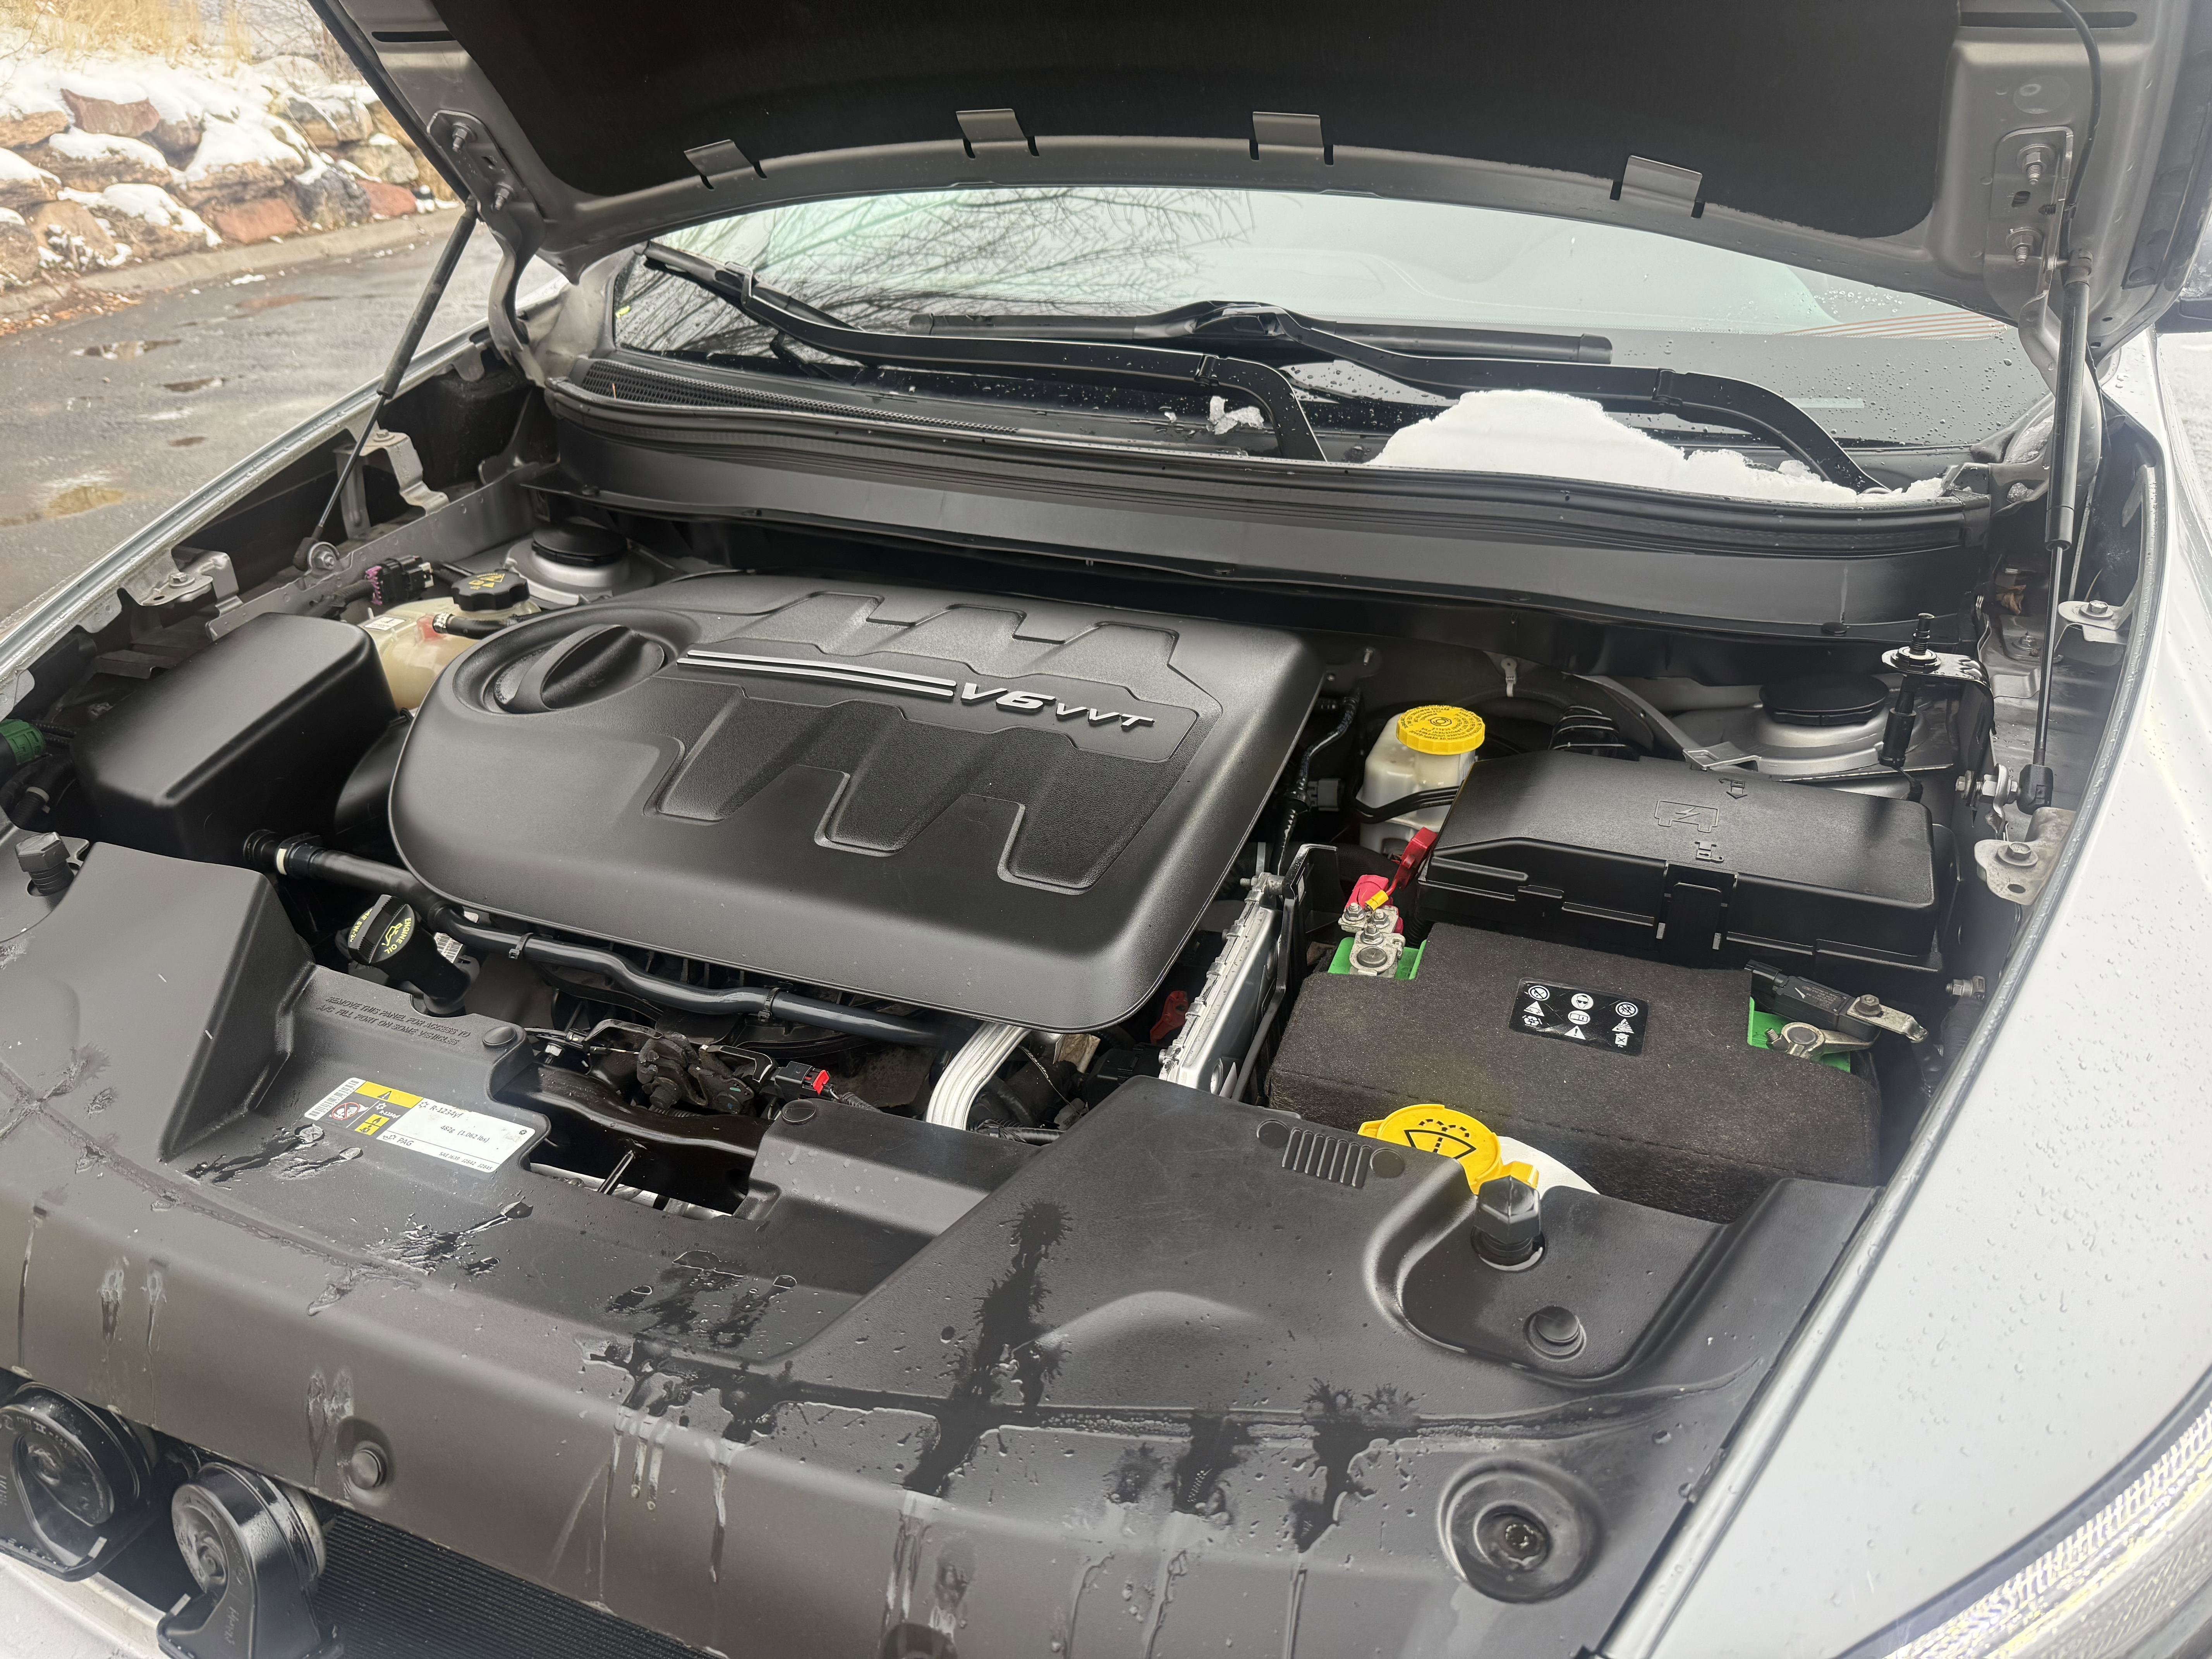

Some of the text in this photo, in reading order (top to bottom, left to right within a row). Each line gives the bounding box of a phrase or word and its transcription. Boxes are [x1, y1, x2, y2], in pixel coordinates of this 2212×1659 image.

[961, 683, 1154, 729] V6 VVT
[384, 917, 411, 954] ENGINE OIL
[316, 1004, 335, 1012] A/C
[335, 1009, 353, 1018] FILL
[354, 1014, 379, 1024] PORT
[391, 1024, 419, 1034] SOME
[418, 1030, 460, 1045] VEHICLES
[326, 996, 362, 1009] REMOVE
[360, 1005, 381, 1014] THIS
[379, 1010, 406, 1021] PANEL
[406, 1017, 425, 1026] FOR
[424, 1022, 459, 1034] ACCESS
[429, 1105, 464, 1118] R-1234yf
[397, 1138, 414, 1146] PAG
[440, 1125, 455, 1133] 482g
[457, 1130, 478, 1139] (1.062
